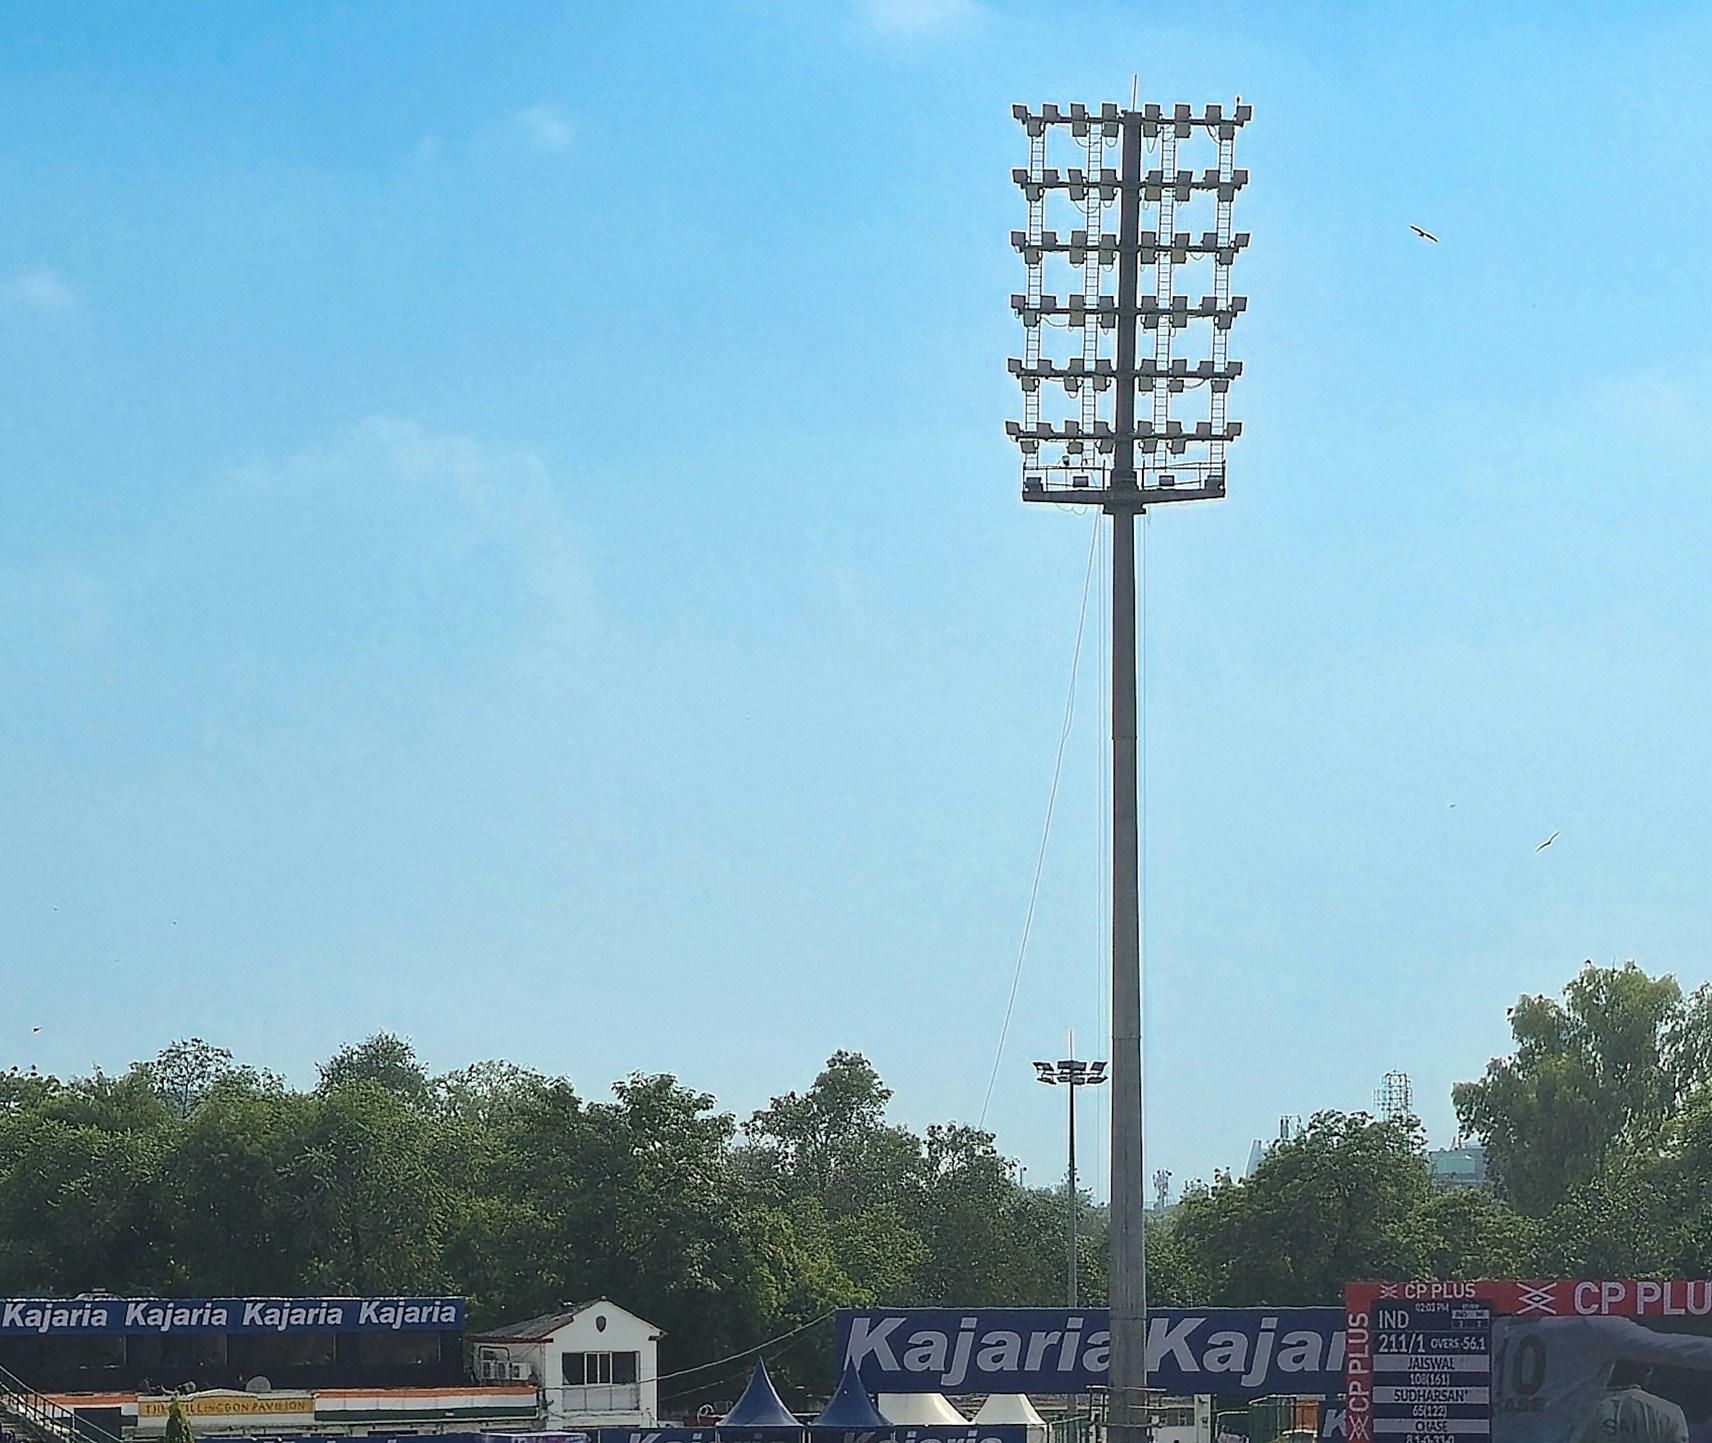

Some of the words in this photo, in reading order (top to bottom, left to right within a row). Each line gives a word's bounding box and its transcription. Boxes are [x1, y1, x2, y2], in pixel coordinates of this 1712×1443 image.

[1405, 1284, 1429, 1298] CP
[1432, 1283, 1475, 1298] PLUS
[1573, 1281, 1627, 1315] CP
[2, 1302, 109, 1330] Kajaria
[124, 1301, 228, 1330] Kajaria
[242, 1300, 343, 1329] Kajaria
[358, 1299, 457, 1328] Kajaria
[1379, 1310, 1409, 1329] IND
[1349, 1312, 1370, 1374] PLUS
[1379, 1334, 1425, 1353] 211/1
[1407, 1357, 1456, 1370] JAISWAL
[1349, 1381, 1370, 1412] CP
